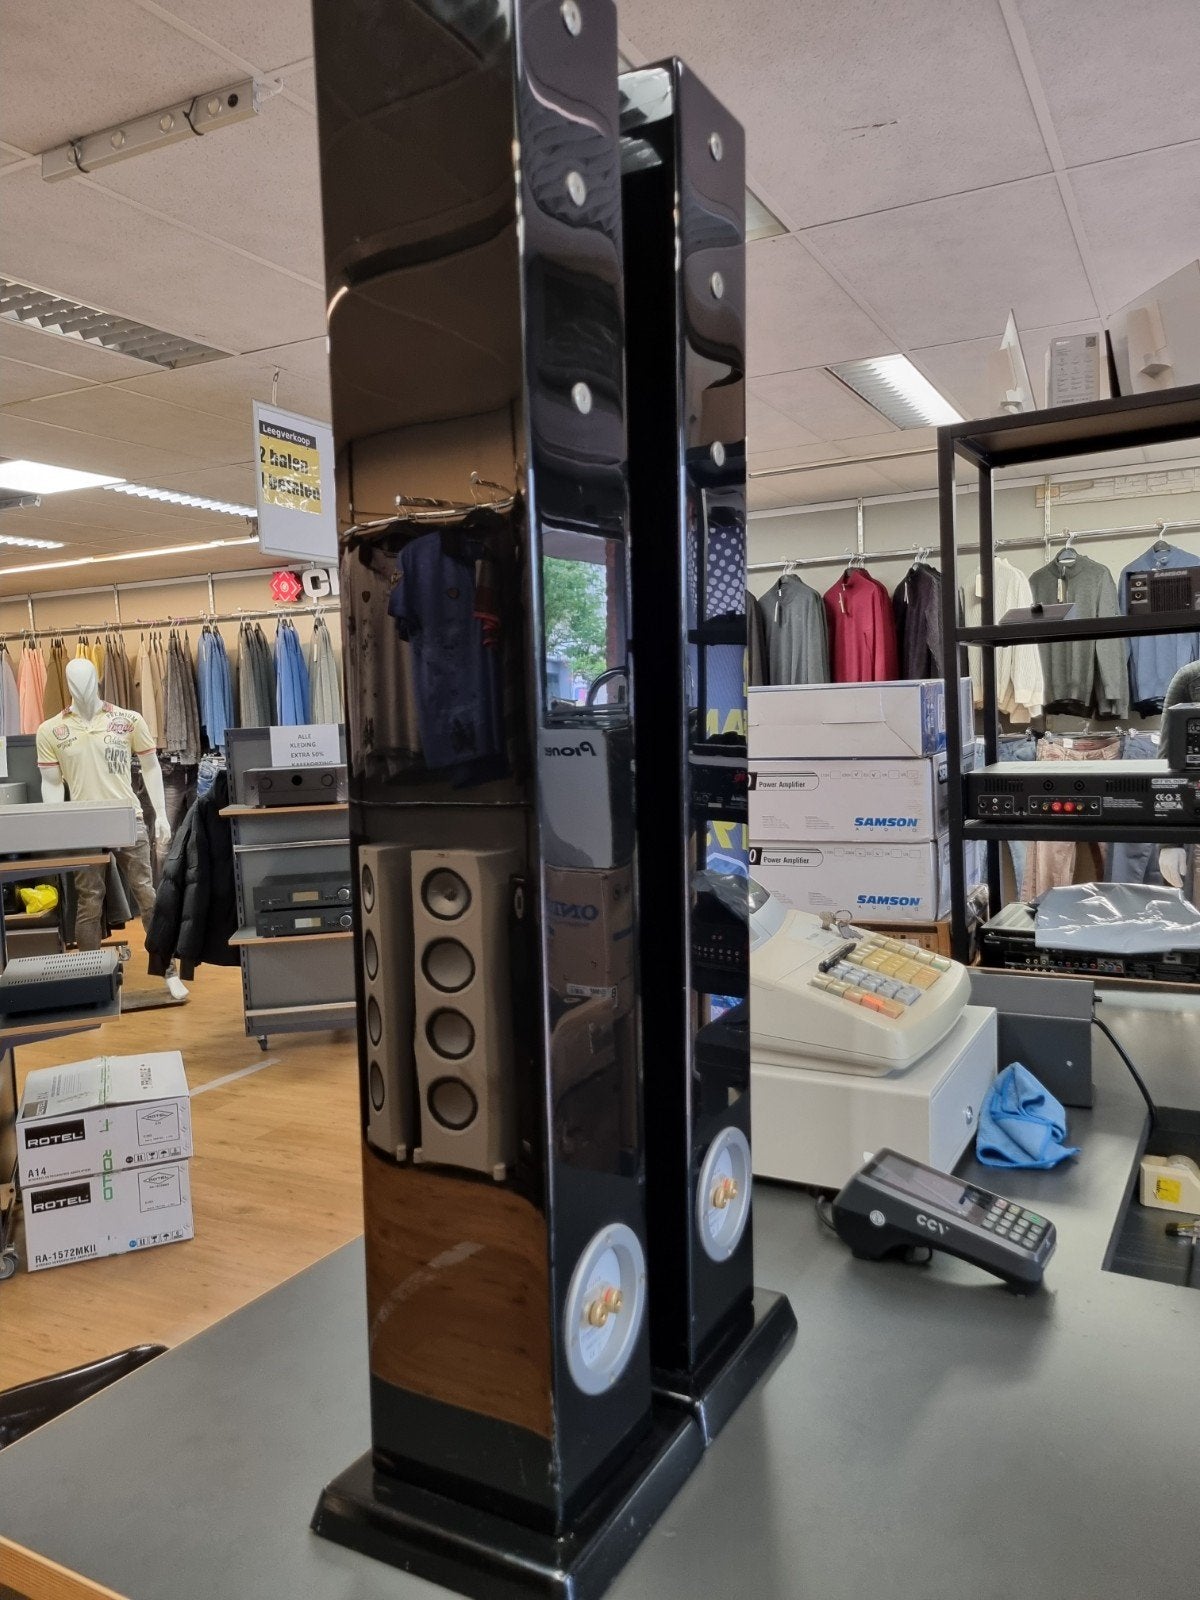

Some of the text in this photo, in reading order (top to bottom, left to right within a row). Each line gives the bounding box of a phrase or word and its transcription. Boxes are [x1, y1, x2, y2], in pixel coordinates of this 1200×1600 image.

[262, 424, 311, 447] Leegverkoop
[269, 449, 309, 474] halen
[778, 781, 806, 790] Amplifier
[854, 817, 919, 827] SAMSON
[783, 857, 810, 866] Amplifier
[857, 895, 921, 906] SAMSON
[27, 1131, 84, 1148] ROTEL
[28, 1167, 46, 1178] A14
[33, 1195, 90, 1212] ROTEL
[35, 1244, 97, 1264] RA-1572MKII
